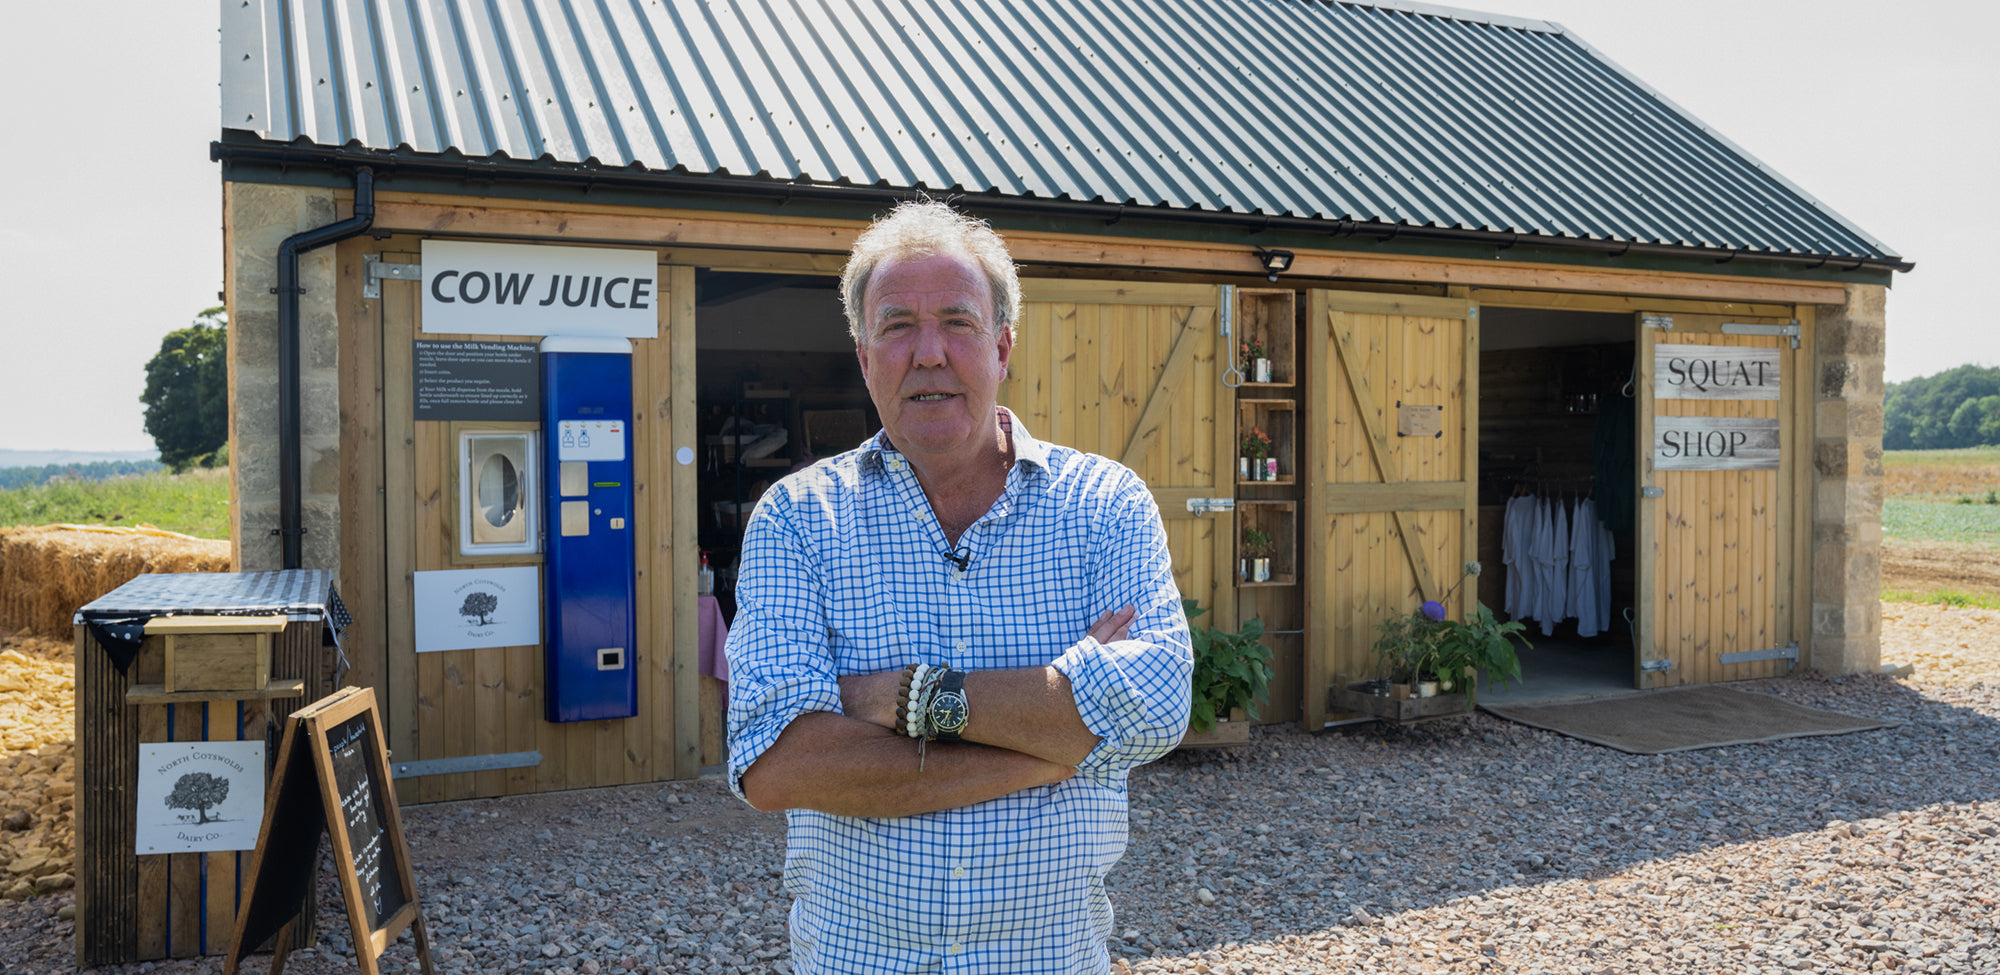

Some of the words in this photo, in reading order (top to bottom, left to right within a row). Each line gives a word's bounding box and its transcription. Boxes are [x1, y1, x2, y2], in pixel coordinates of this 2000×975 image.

[431, 270, 534, 305] COW
[539, 274, 652, 310] JUICE
[480, 344, 506, 352] Vending
[1667, 357, 1771, 392] SQUAT
[1661, 430, 1747, 458] SHOP
[158, 756, 190, 775] NORTH
[193, 752, 244, 772] COTSWOLDS
[176, 832, 203, 842] DAIRY
